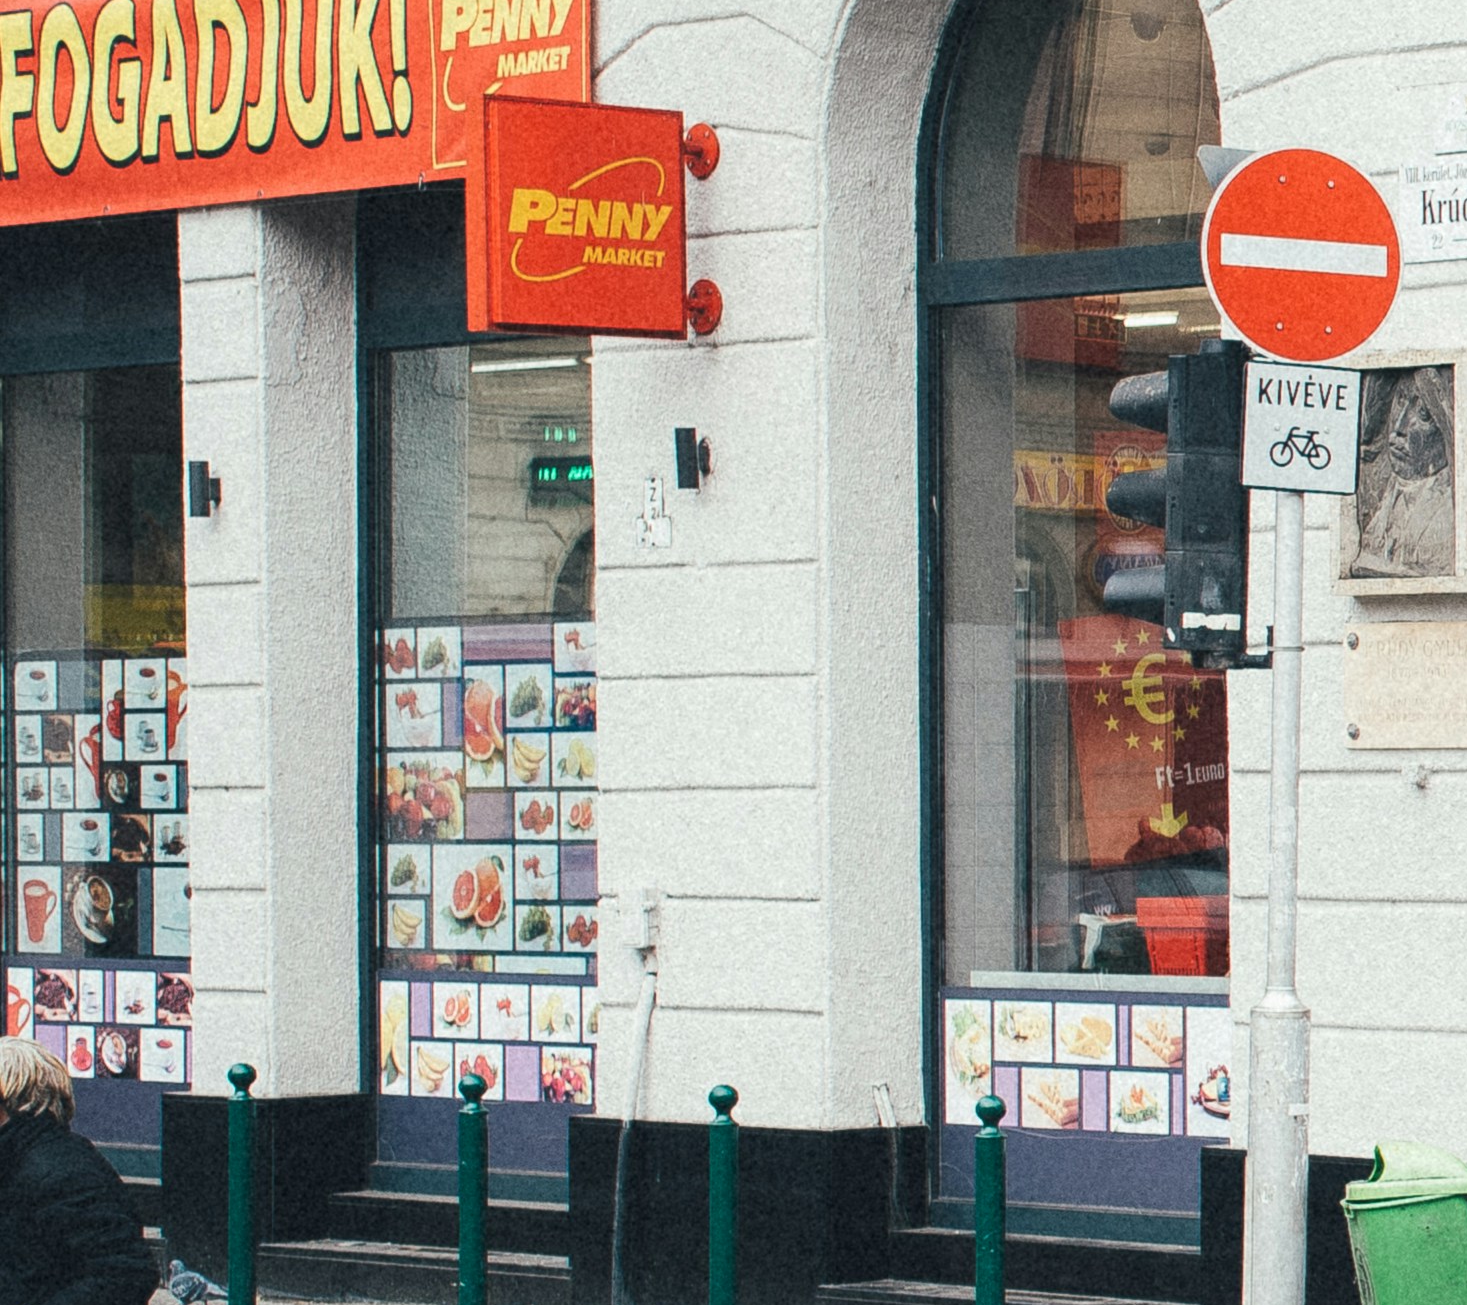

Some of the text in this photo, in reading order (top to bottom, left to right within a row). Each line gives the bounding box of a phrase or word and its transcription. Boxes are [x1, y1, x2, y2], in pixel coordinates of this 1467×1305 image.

[496, 45, 571, 80] MARKET
[507, 187, 673, 242] PENNY
[582, 244, 666, 269] MARKET
[1257, 375, 1348, 412] KIVÉVE
